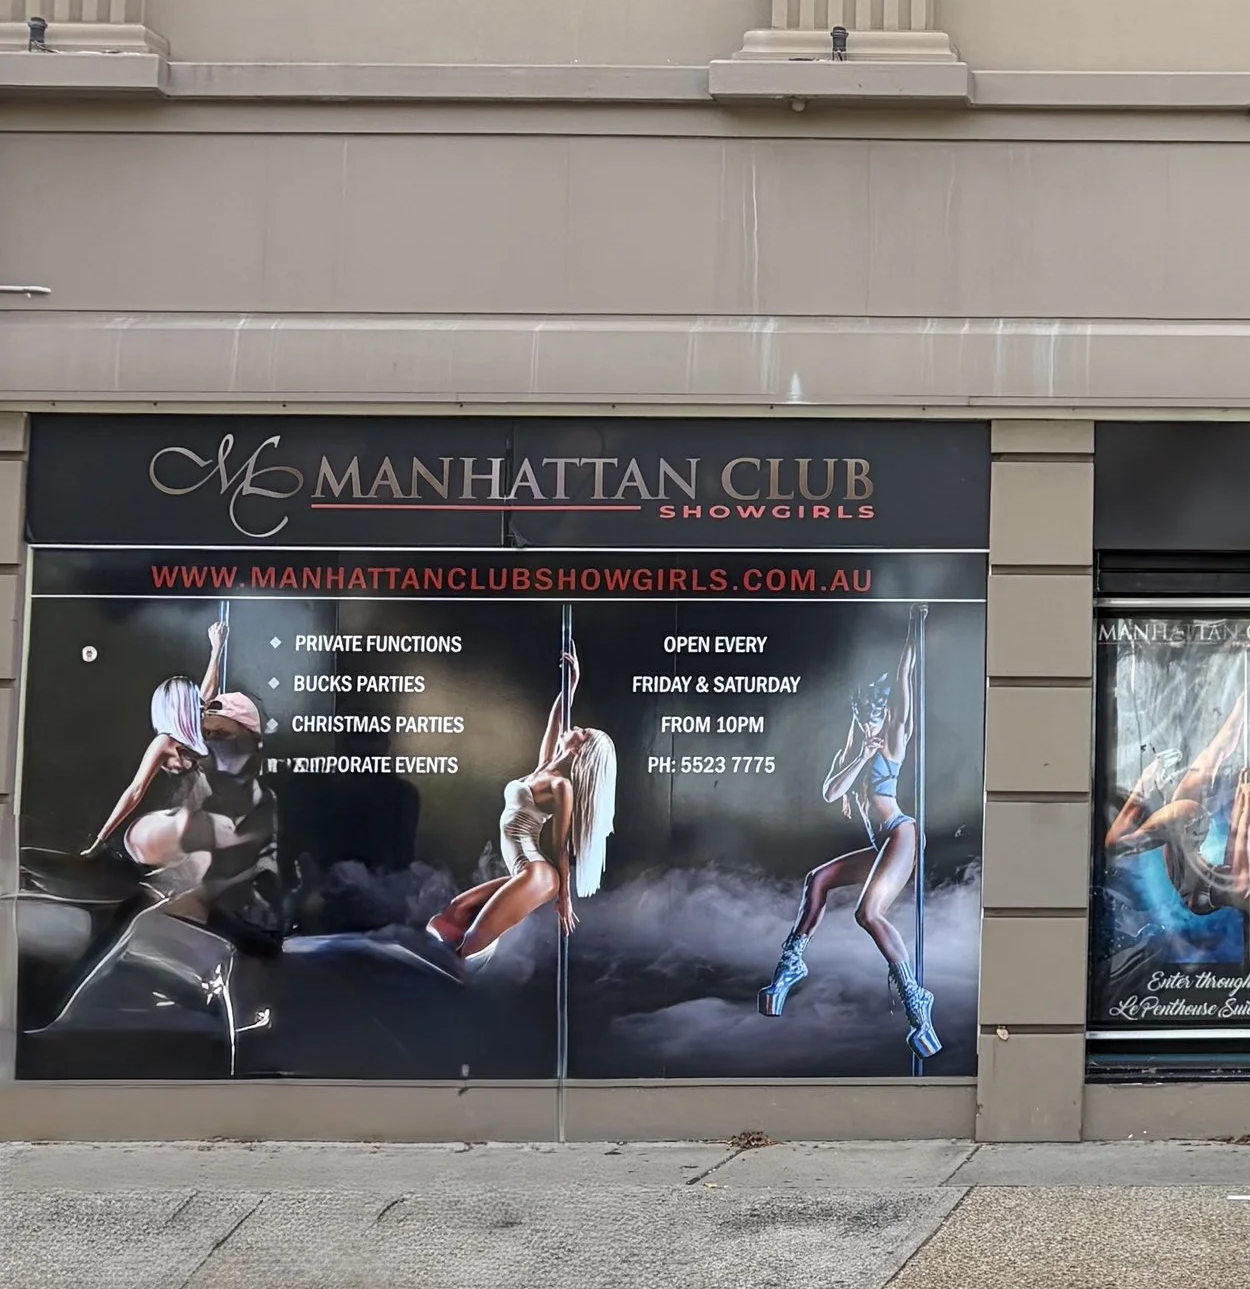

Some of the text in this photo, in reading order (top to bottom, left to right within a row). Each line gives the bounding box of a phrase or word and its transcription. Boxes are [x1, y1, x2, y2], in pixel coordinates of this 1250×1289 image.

[310, 454, 875, 501] MANHATTAN CLUB
[658, 504, 876, 520] SHOWGIRLS
[151, 565, 872, 592] WWW.MANHATTANCLUBSHOWGIRLS.COM.AU
[295, 635, 462, 653] PRIVATE FUNCTIONS
[664, 636, 768, 653] OPEN EVERY
[294, 675, 425, 693] BUCKS PARTIES
[632, 675, 801, 693] FRIDAY & SATURDAY
[292, 715, 464, 734] CHRISTMAS PARTIES
[661, 716, 764, 733] FROM 10PM
[395, 757, 459, 774] EVENTS
[647, 756, 776, 773] PH: 5523 7775
[1147, 970, 1194, 991] Enter
[1109, 995, 1140, 1021] Le
[1139, 996, 1218, 1018] Penthouse
